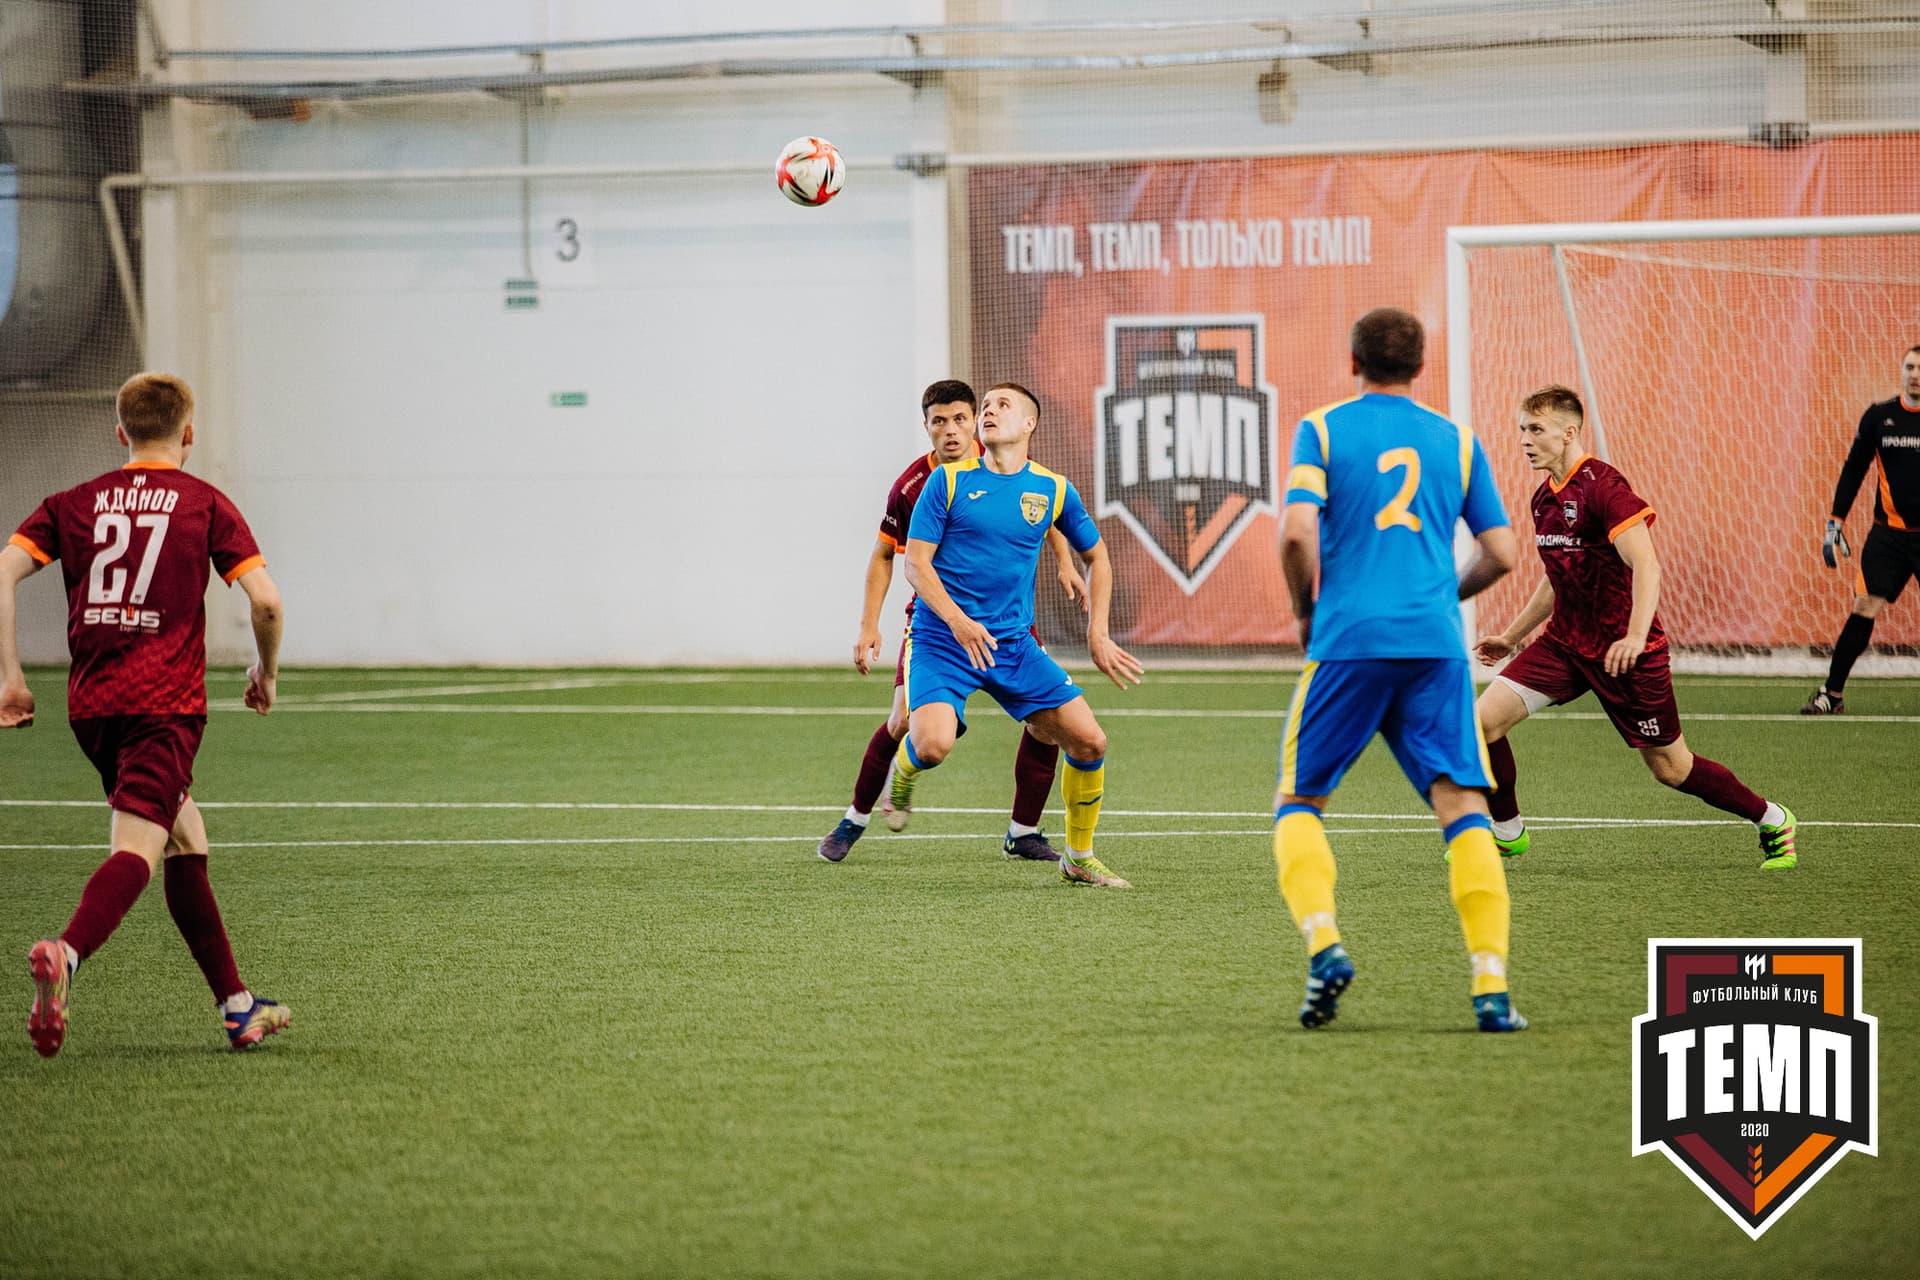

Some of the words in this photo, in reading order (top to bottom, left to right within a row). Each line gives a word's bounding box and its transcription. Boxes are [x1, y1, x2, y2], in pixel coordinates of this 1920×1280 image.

[555, 217, 581, 263] 3
[1003, 223, 1084, 278] ТЕМП,
[1089, 219, 1171, 276] ТЕМП,
[1175, 216, 1284, 269] ТОЛЬКО
[1290, 214, 1373, 267] ТЕМП!
[1113, 391, 1262, 488] ТЕМП
[93, 487, 180, 514] ЖДАНОВ
[1374, 446, 1422, 532] 2
[87, 513, 170, 605] 27
